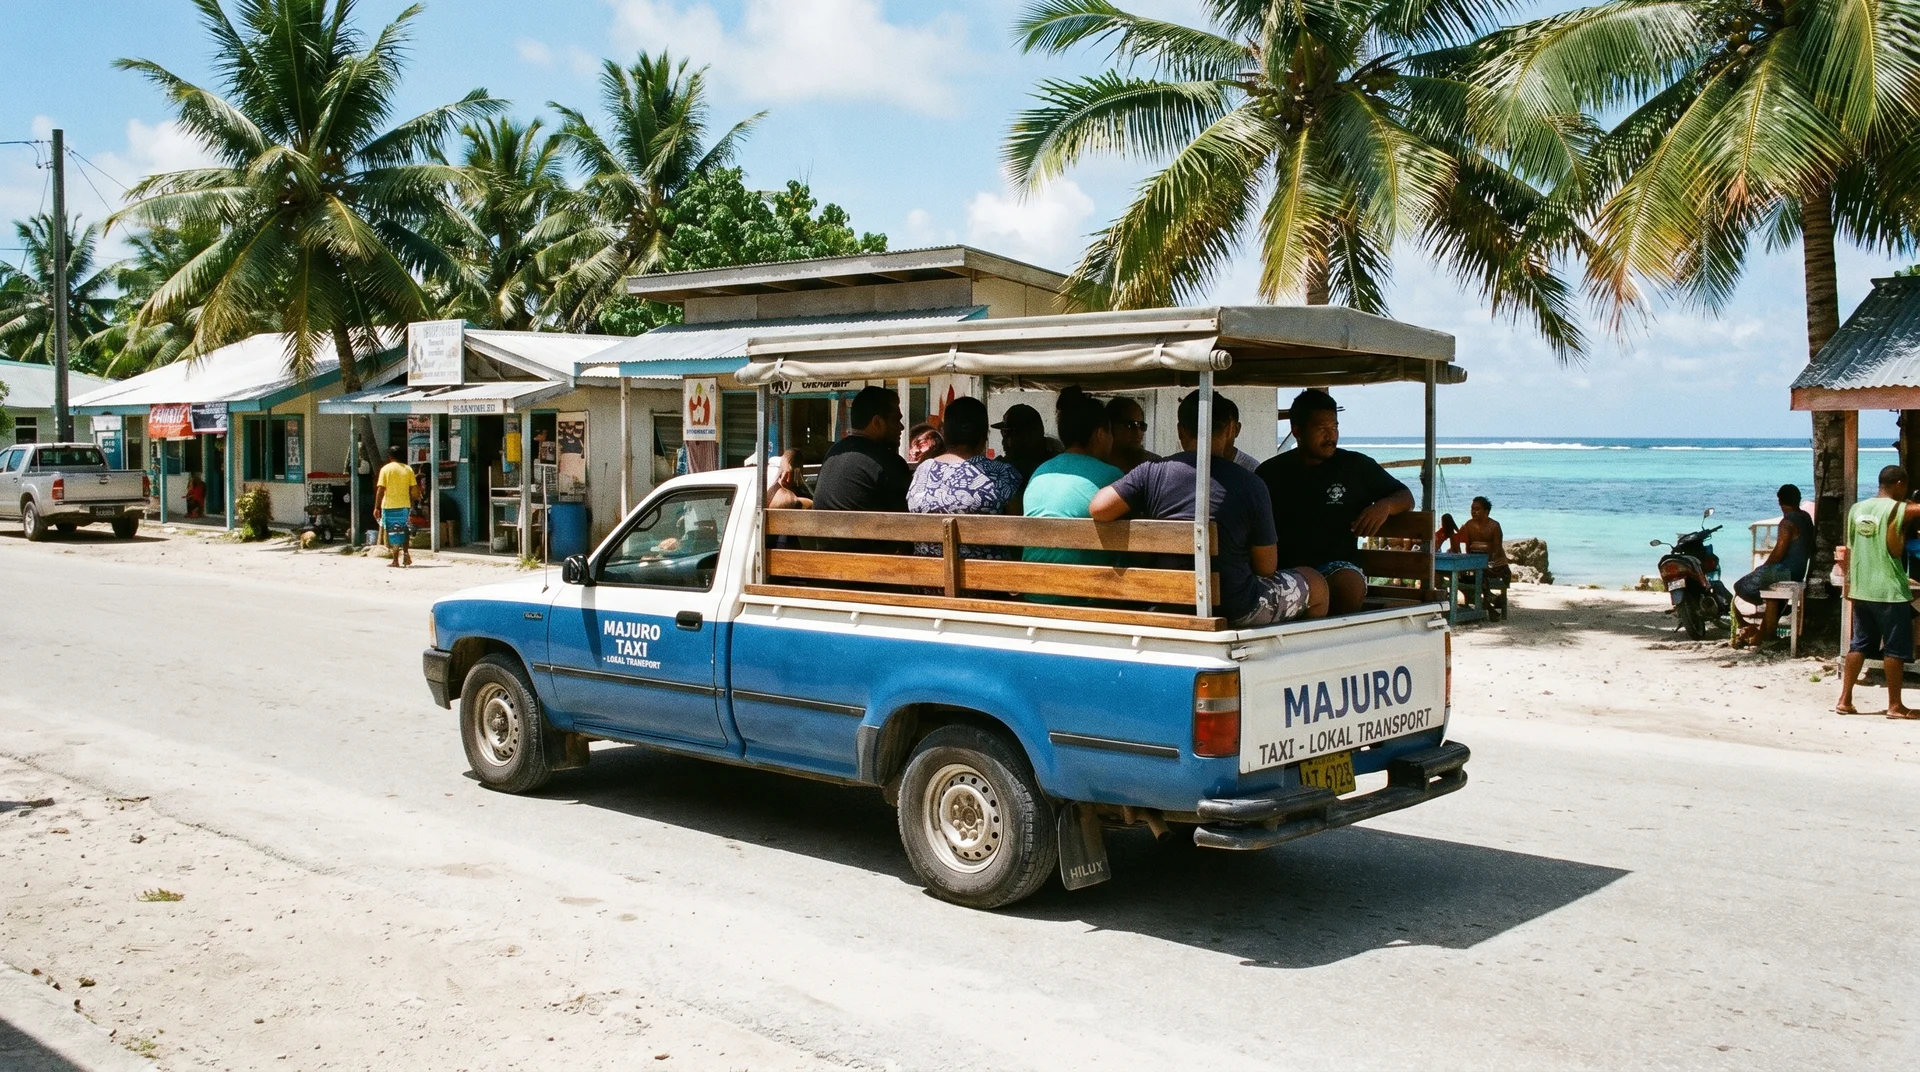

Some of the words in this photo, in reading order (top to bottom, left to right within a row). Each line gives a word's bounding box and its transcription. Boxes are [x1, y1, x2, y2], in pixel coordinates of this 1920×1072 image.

[604, 620, 660, 641] MAJURO
[615, 639, 648, 657] TAXI
[1284, 665, 1412, 729] MAJURO
[1259, 738, 1295, 765] TAXI
[1309, 726, 1353, 754] LOKAL
[1357, 707, 1432, 742] TRANSPORT
[1070, 861, 1104, 879] HILUX
